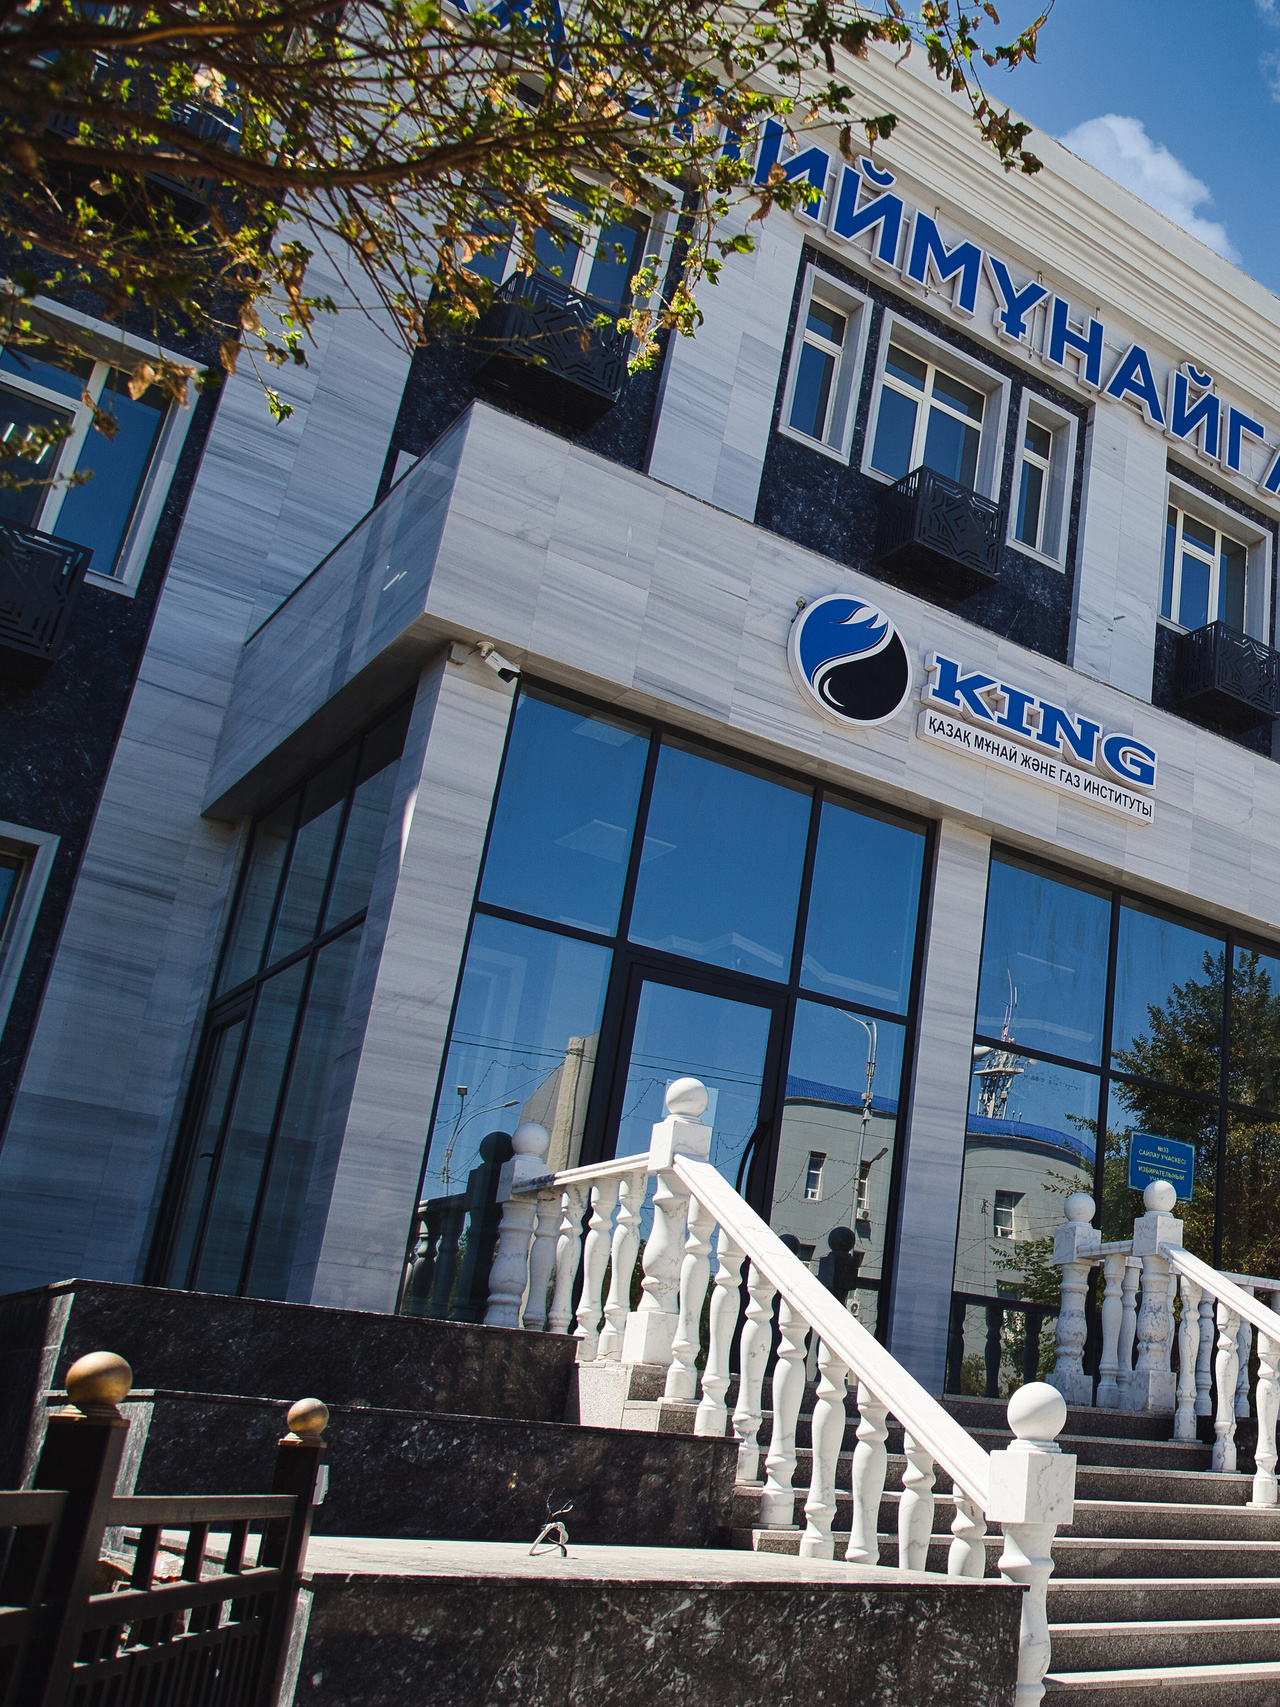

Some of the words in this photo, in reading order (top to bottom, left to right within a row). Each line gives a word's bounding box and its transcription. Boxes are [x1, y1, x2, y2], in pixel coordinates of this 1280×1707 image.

[928, 715, 972, 750] ҚАЗАҚ
[973, 733, 1018, 764] МҰНАЙ
[1020, 752, 1057, 780] ЖӘНЕ
[1059, 767, 1081, 788] ГАЗ
[1083, 777, 1153, 819] ИНСТИТУТЫ
[931, 655, 1156, 786] KING
[1138, 1166, 1185, 1180] ИЗБИРАТЕЛЬНЫЙ
